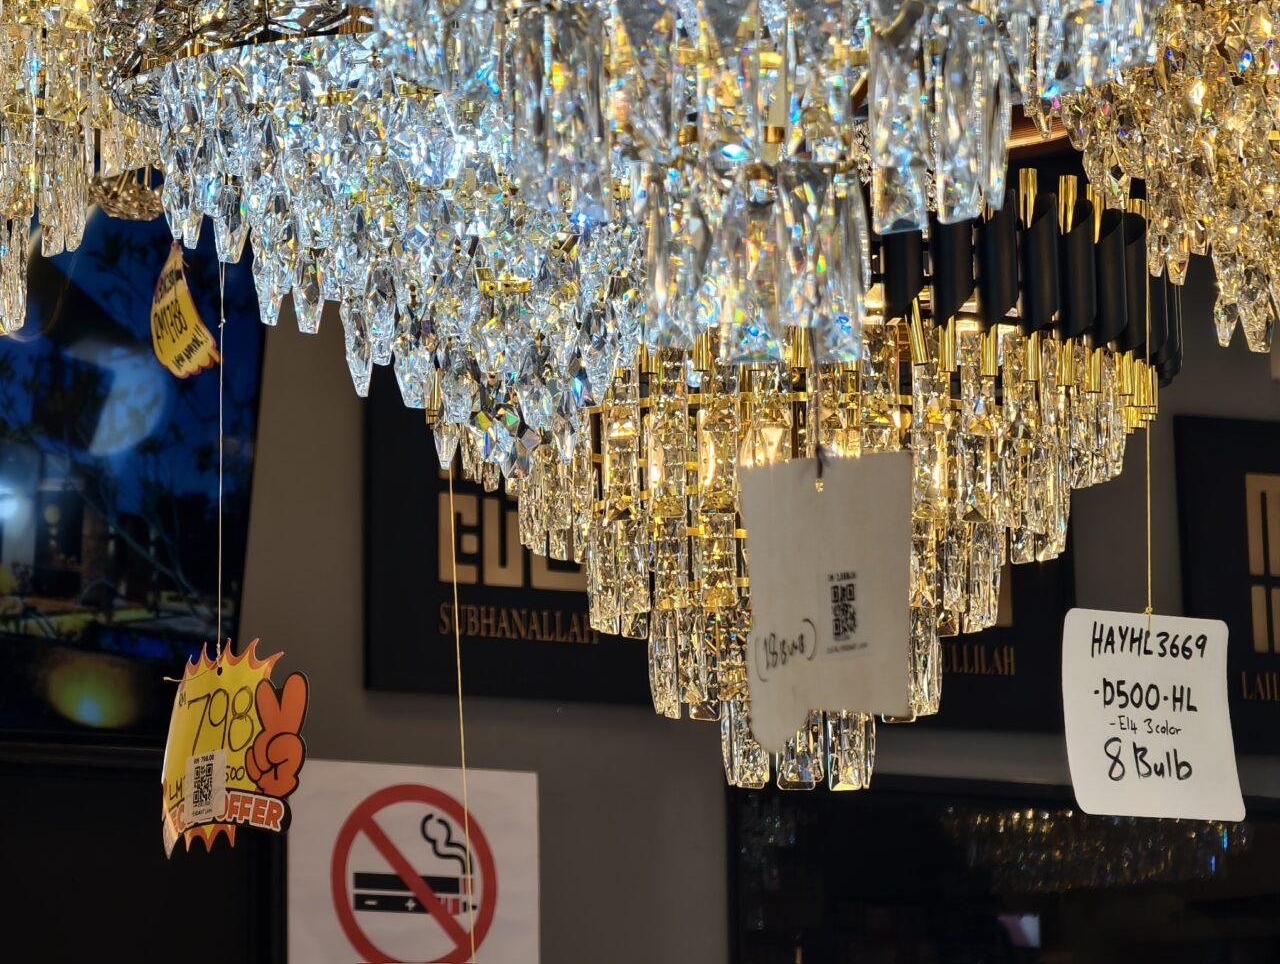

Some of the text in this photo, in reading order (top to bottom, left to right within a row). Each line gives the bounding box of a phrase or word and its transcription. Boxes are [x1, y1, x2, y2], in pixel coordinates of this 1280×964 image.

[187, 685, 255, 757] 798
[1104, 736, 1193, 782] 8 Bulb
